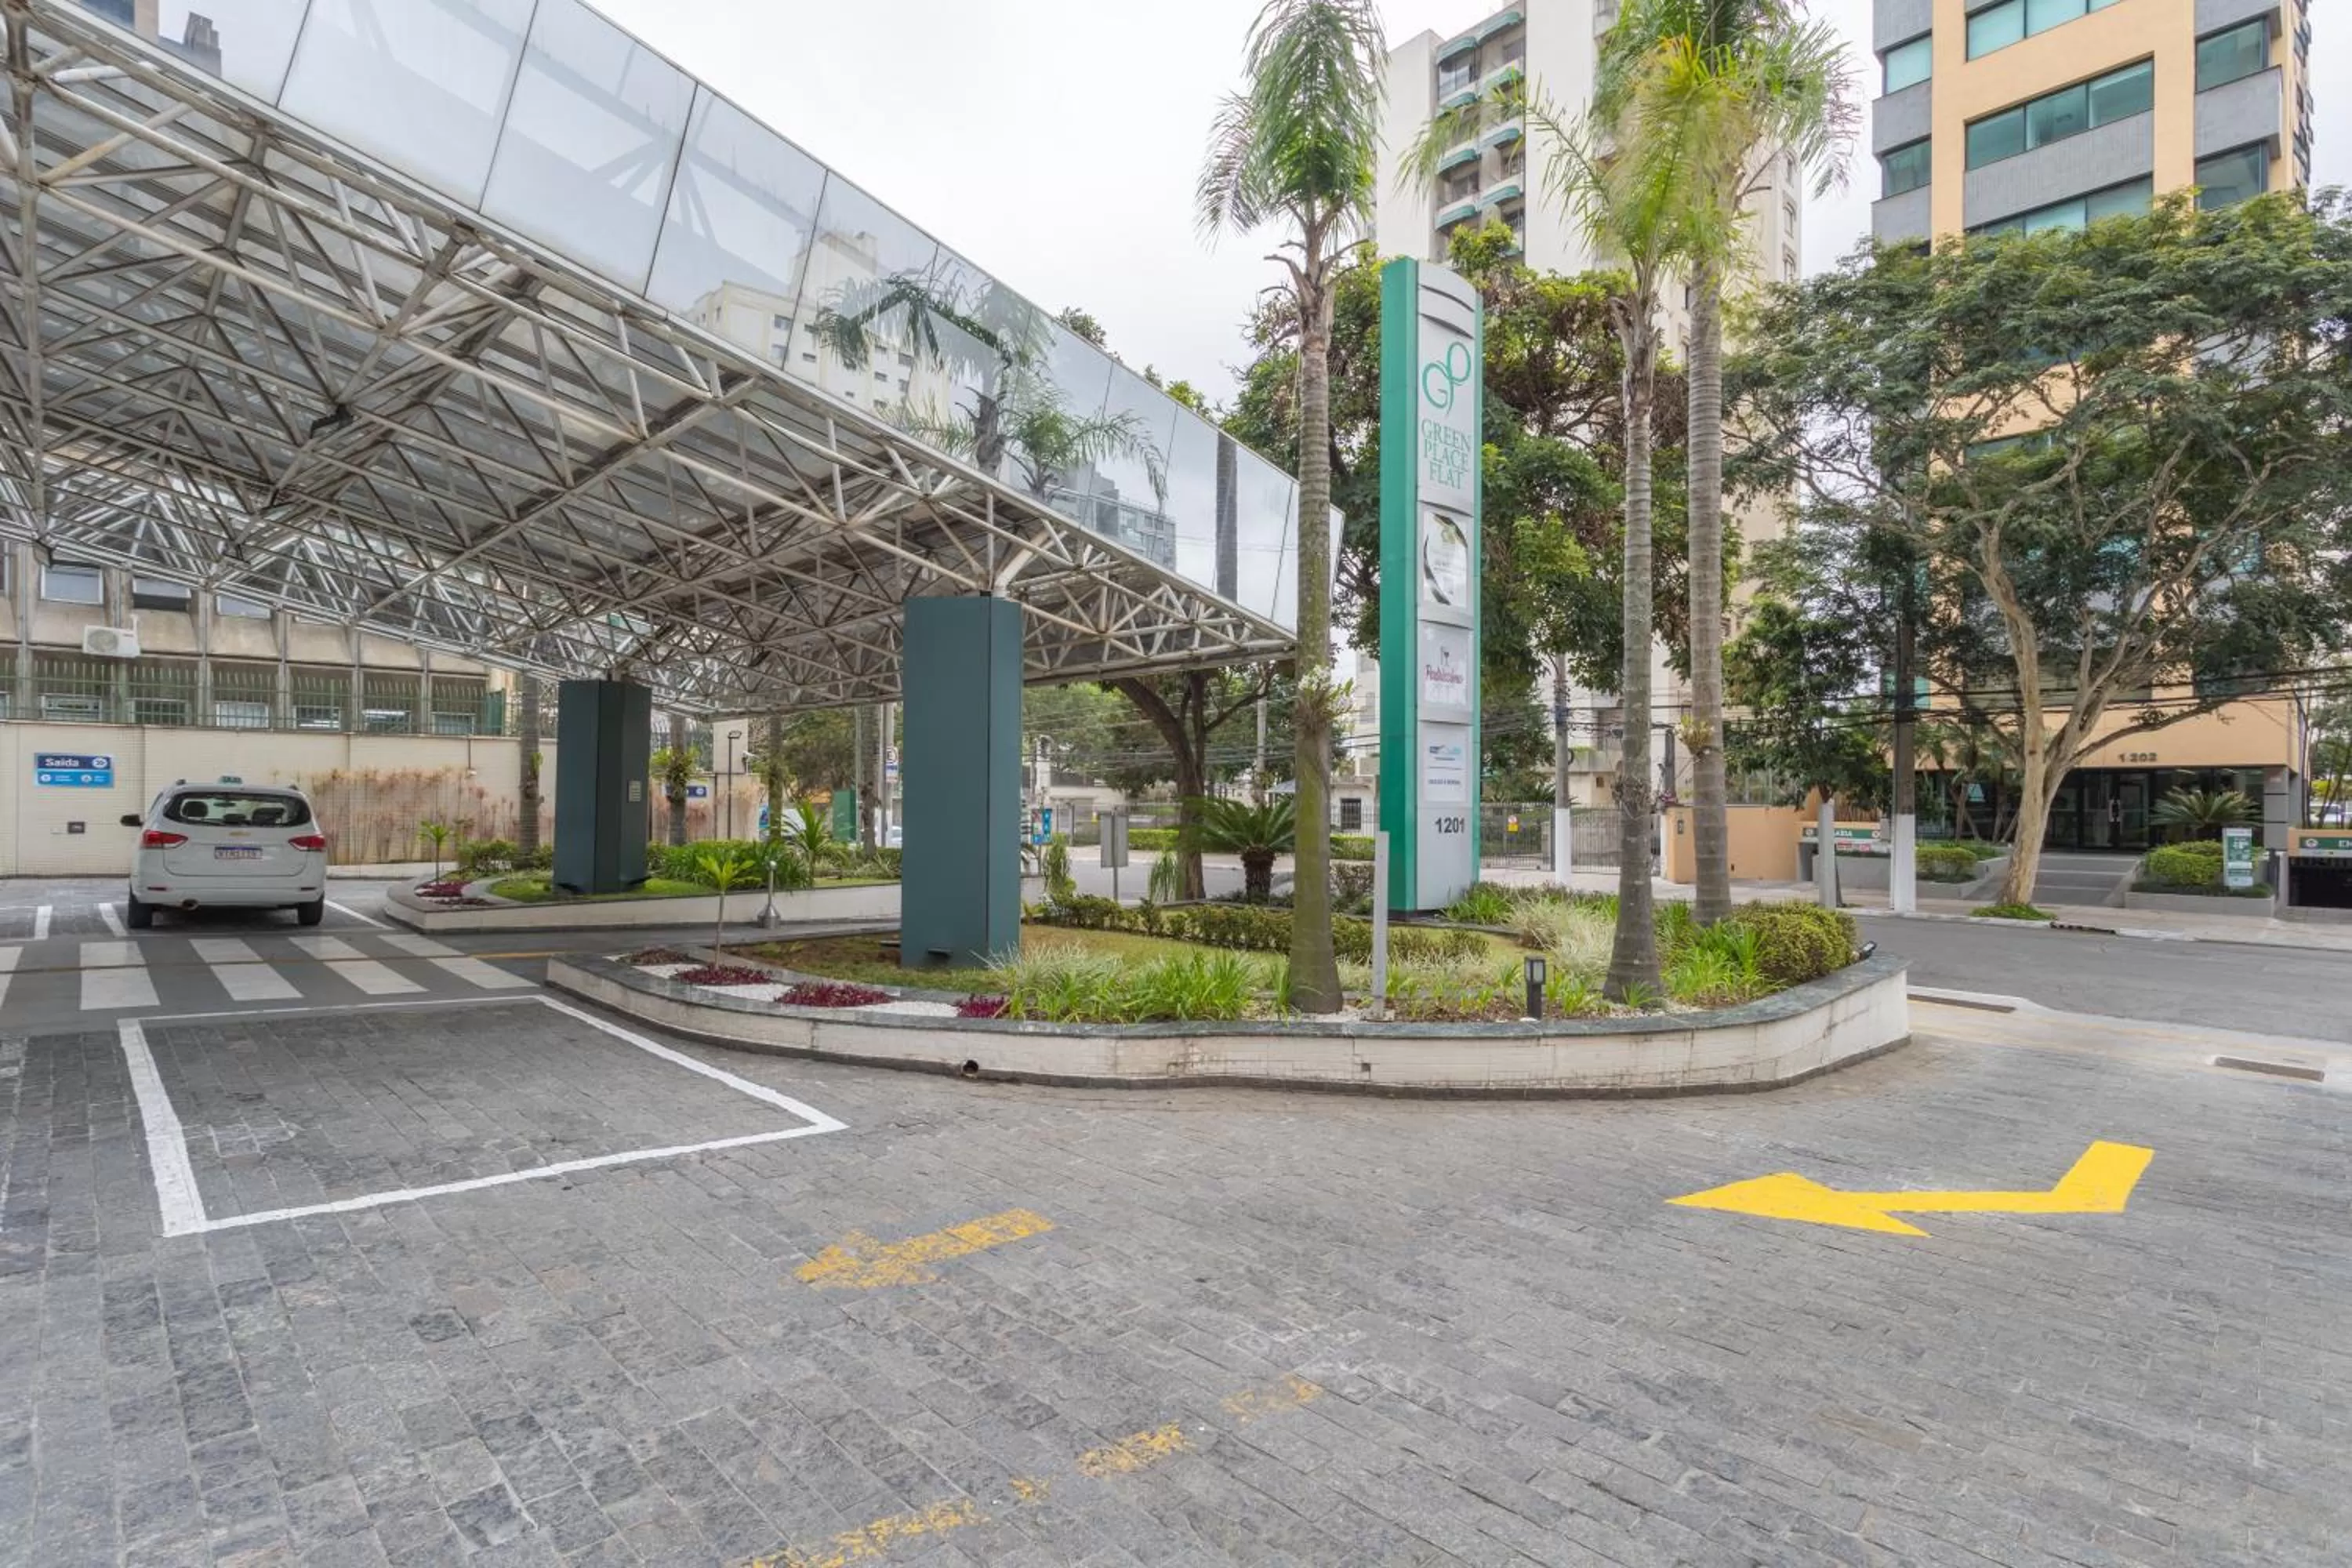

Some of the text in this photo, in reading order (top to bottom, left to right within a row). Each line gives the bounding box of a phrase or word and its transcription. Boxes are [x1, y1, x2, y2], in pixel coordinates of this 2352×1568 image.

[1421, 419, 1471, 452] GREEN
[1423, 437, 1468, 472] PLACE
[1429, 460, 1465, 489] FLAT
[1435, 817, 1465, 834] 1201
